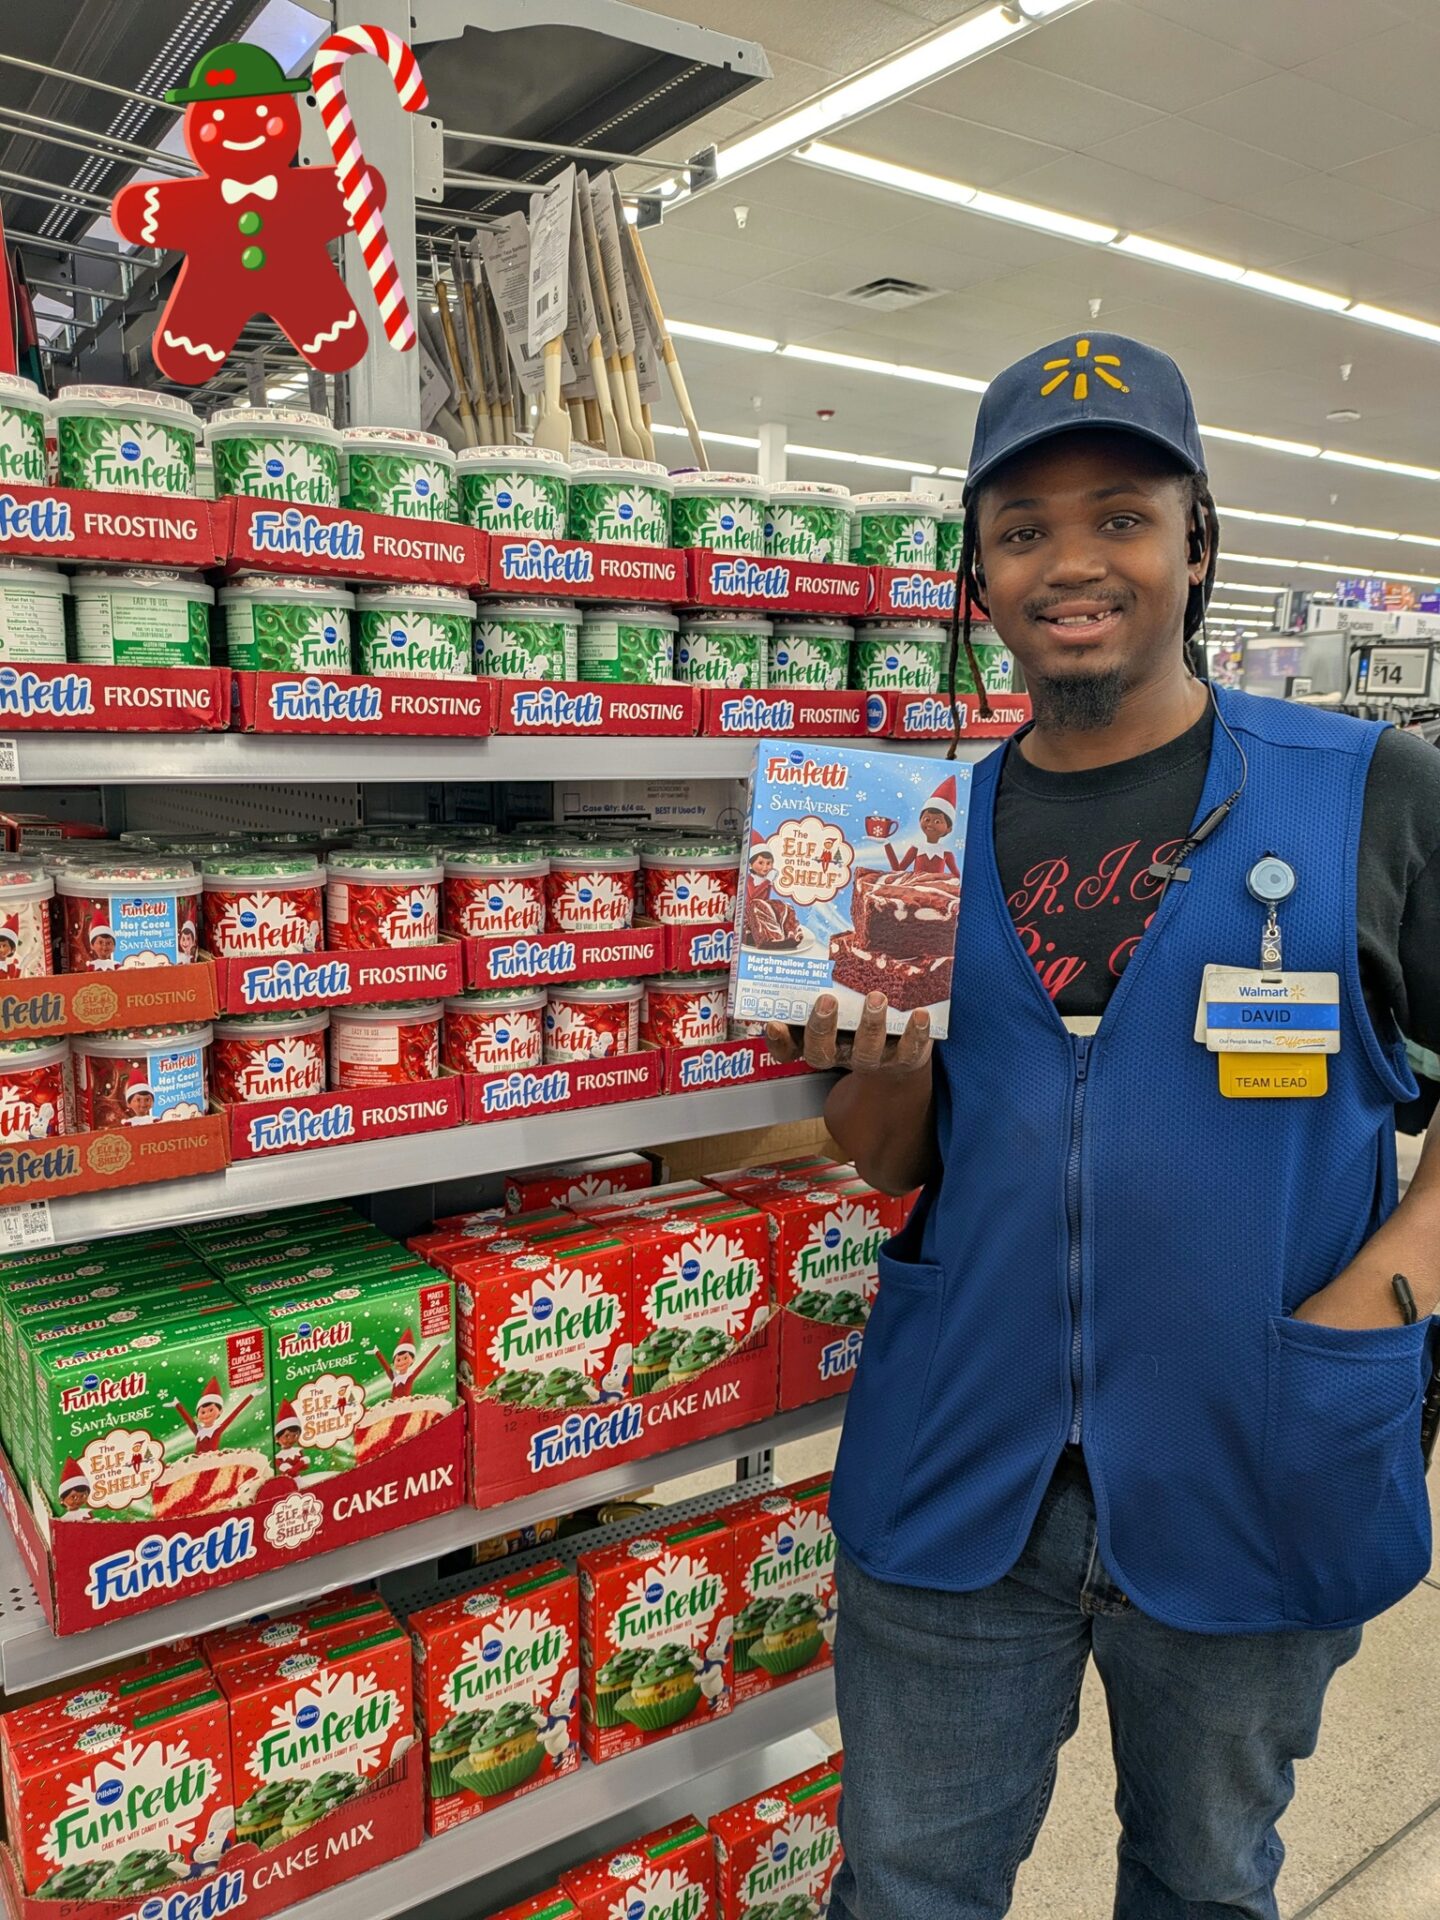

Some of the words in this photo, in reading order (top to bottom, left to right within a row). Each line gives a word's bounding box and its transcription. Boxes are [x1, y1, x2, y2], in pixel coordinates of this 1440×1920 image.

[92, 454, 189, 494] Funfetti
[242, 473, 331, 504] Funfetti
[0, 495, 72, 538] fetti
[84, 512, 198, 541] FROSTING
[390, 489, 450, 521] Funfett
[475, 504, 556, 532] Funfetti
[250, 513, 363, 557] Funfetti
[373, 535, 466, 564] FROSTING
[596, 515, 666, 543] Funfetti
[699, 527, 763, 550] Funfetti
[763, 529, 813, 556] nfetti
[502, 546, 593, 582] Funfetti
[600, 560, 676, 581] FROSTING
[711, 563, 789, 598] Funfetti
[794, 577, 860, 597] FROSTING
[890, 578, 958, 609] Funfett
[371, 640, 454, 670] Funfetti
[867, 664, 932, 688] Funfetti
[1373, 665, 1403, 685] $14
[0, 675, 93, 714] nfetti
[104, 686, 210, 709] FROSTING
[272, 684, 380, 720] Funfetti
[391, 696, 481, 716] FROSTING
[514, 694, 602, 724] Funfetti
[609, 702, 684, 721] FROSTING
[722, 702, 793, 731] Funfetti
[800, 709, 860, 724] FROSTING
[765, 757, 849, 789] Funfetti
[783, 837, 817, 858] ELF
[793, 829, 808, 840] The
[797, 857, 811, 867] the
[779, 867, 838, 890] SHELF
[120, 901, 168, 917] Funfetti
[466, 905, 540, 932] Funfetti
[556, 898, 630, 922] Funfetti
[658, 895, 728, 919] Funfetti
[114, 929, 139, 938] Whipped
[120, 921, 139, 929] Hot
[141, 920, 171, 929] Cocoa
[218, 919, 305, 951] Funfetti
[489, 942, 574, 978] Funfetti
[582, 944, 654, 964] FROSTING
[748, 955, 805, 968] Marshmallow
[807, 961, 829, 970] Swirl
[748, 963, 773, 975] Fudge
[775, 966, 810, 977] Brownie
[812, 970, 828, 978] Mix
[244, 962, 350, 1001] Funfetti
[359, 963, 448, 986] FROSTING
[1239, 986, 1289, 998] Walmart
[0, 993, 66, 1029] fetti
[127, 989, 197, 1008] FROSTING
[1241, 1009, 1291, 1023] DAVID
[473, 1031, 540, 1065] Funfetti
[1275, 1035, 1326, 1047] Difference
[159, 1054, 198, 1073] Funfetti
[680, 1050, 753, 1086] Funfetti
[159, 1076, 176, 1085] Hot
[177, 1072, 199, 1082] Cocoa
[242, 1062, 322, 1096] Funfetti
[484, 1074, 569, 1113] Funfetti
[576, 1066, 649, 1091] FROSTING
[1235, 1077, 1270, 1088] TEAM
[1273, 1077, 1308, 1088] LEAD
[250, 1105, 353, 1150] Funfetti
[361, 1098, 449, 1127] FROSTING
[0, 1148, 79, 1184] nfetti
[140, 1134, 208, 1156] FROSTING
[430, 1299, 441, 1308] 24
[652, 1261, 756, 1319] Funfetti
[279, 1321, 351, 1360] Funfetti
[498, 1297, 616, 1363] Funfetti
[56, 1345, 128, 1369] Funfetti
[240, 1345, 251, 1355] 24
[60, 1372, 147, 1414] Funfetti
[301, 1394, 333, 1416] ELF
[310, 1388, 324, 1397] The
[70, 1407, 155, 1437] SANTAVERSE
[302, 1412, 354, 1442] SHELF
[316, 1411, 329, 1420] the
[530, 1406, 641, 1470] Funfetti
[648, 1395, 698, 1426] CAKE
[703, 1380, 741, 1411] MIX
[90, 1450, 126, 1474] ELF
[99, 1444, 116, 1453] The
[92, 1470, 151, 1502] SHELF
[95, 1473, 106, 1481] on
[107, 1468, 122, 1478] the
[275, 1508, 299, 1526] ELF
[89, 1519, 255, 1608] Funfetti
[332, 1481, 399, 1522] CAKE
[403, 1464, 454, 1500] MIX
[275, 1521, 314, 1544] SHELF
[751, 1531, 838, 1592] Funfett
[615, 1577, 718, 1642] Funfetti
[450, 1628, 564, 1706] Funfetti
[65, 1692, 110, 1715] Funfetti
[296, 1710, 319, 1723] Pillsbury
[76, 1725, 124, 1749] Funfetti
[256, 1694, 393, 1775] Funfetti
[300, 1761, 311, 1771] CAKE
[312, 1758, 321, 1767] MIX
[322, 1755, 333, 1764] WITH
[334, 1749, 348, 1760] CANDY
[349, 1743, 359, 1753] BITS
[561, 1752, 577, 1771] 24
[97, 1784, 123, 1800] Pillsbury
[51, 1762, 207, 1858] Funfetti
[101, 1839, 115, 1852] CAKE
[115, 1836, 126, 1848] MIX
[127, 1830, 140, 1843] WITH
[141, 1824, 157, 1838] CANDY
[158, 1818, 170, 1831] BITS
[252, 1850, 319, 1890] CAKE
[324, 1820, 375, 1860] MIX
[746, 1831, 836, 1901] Funfetti
